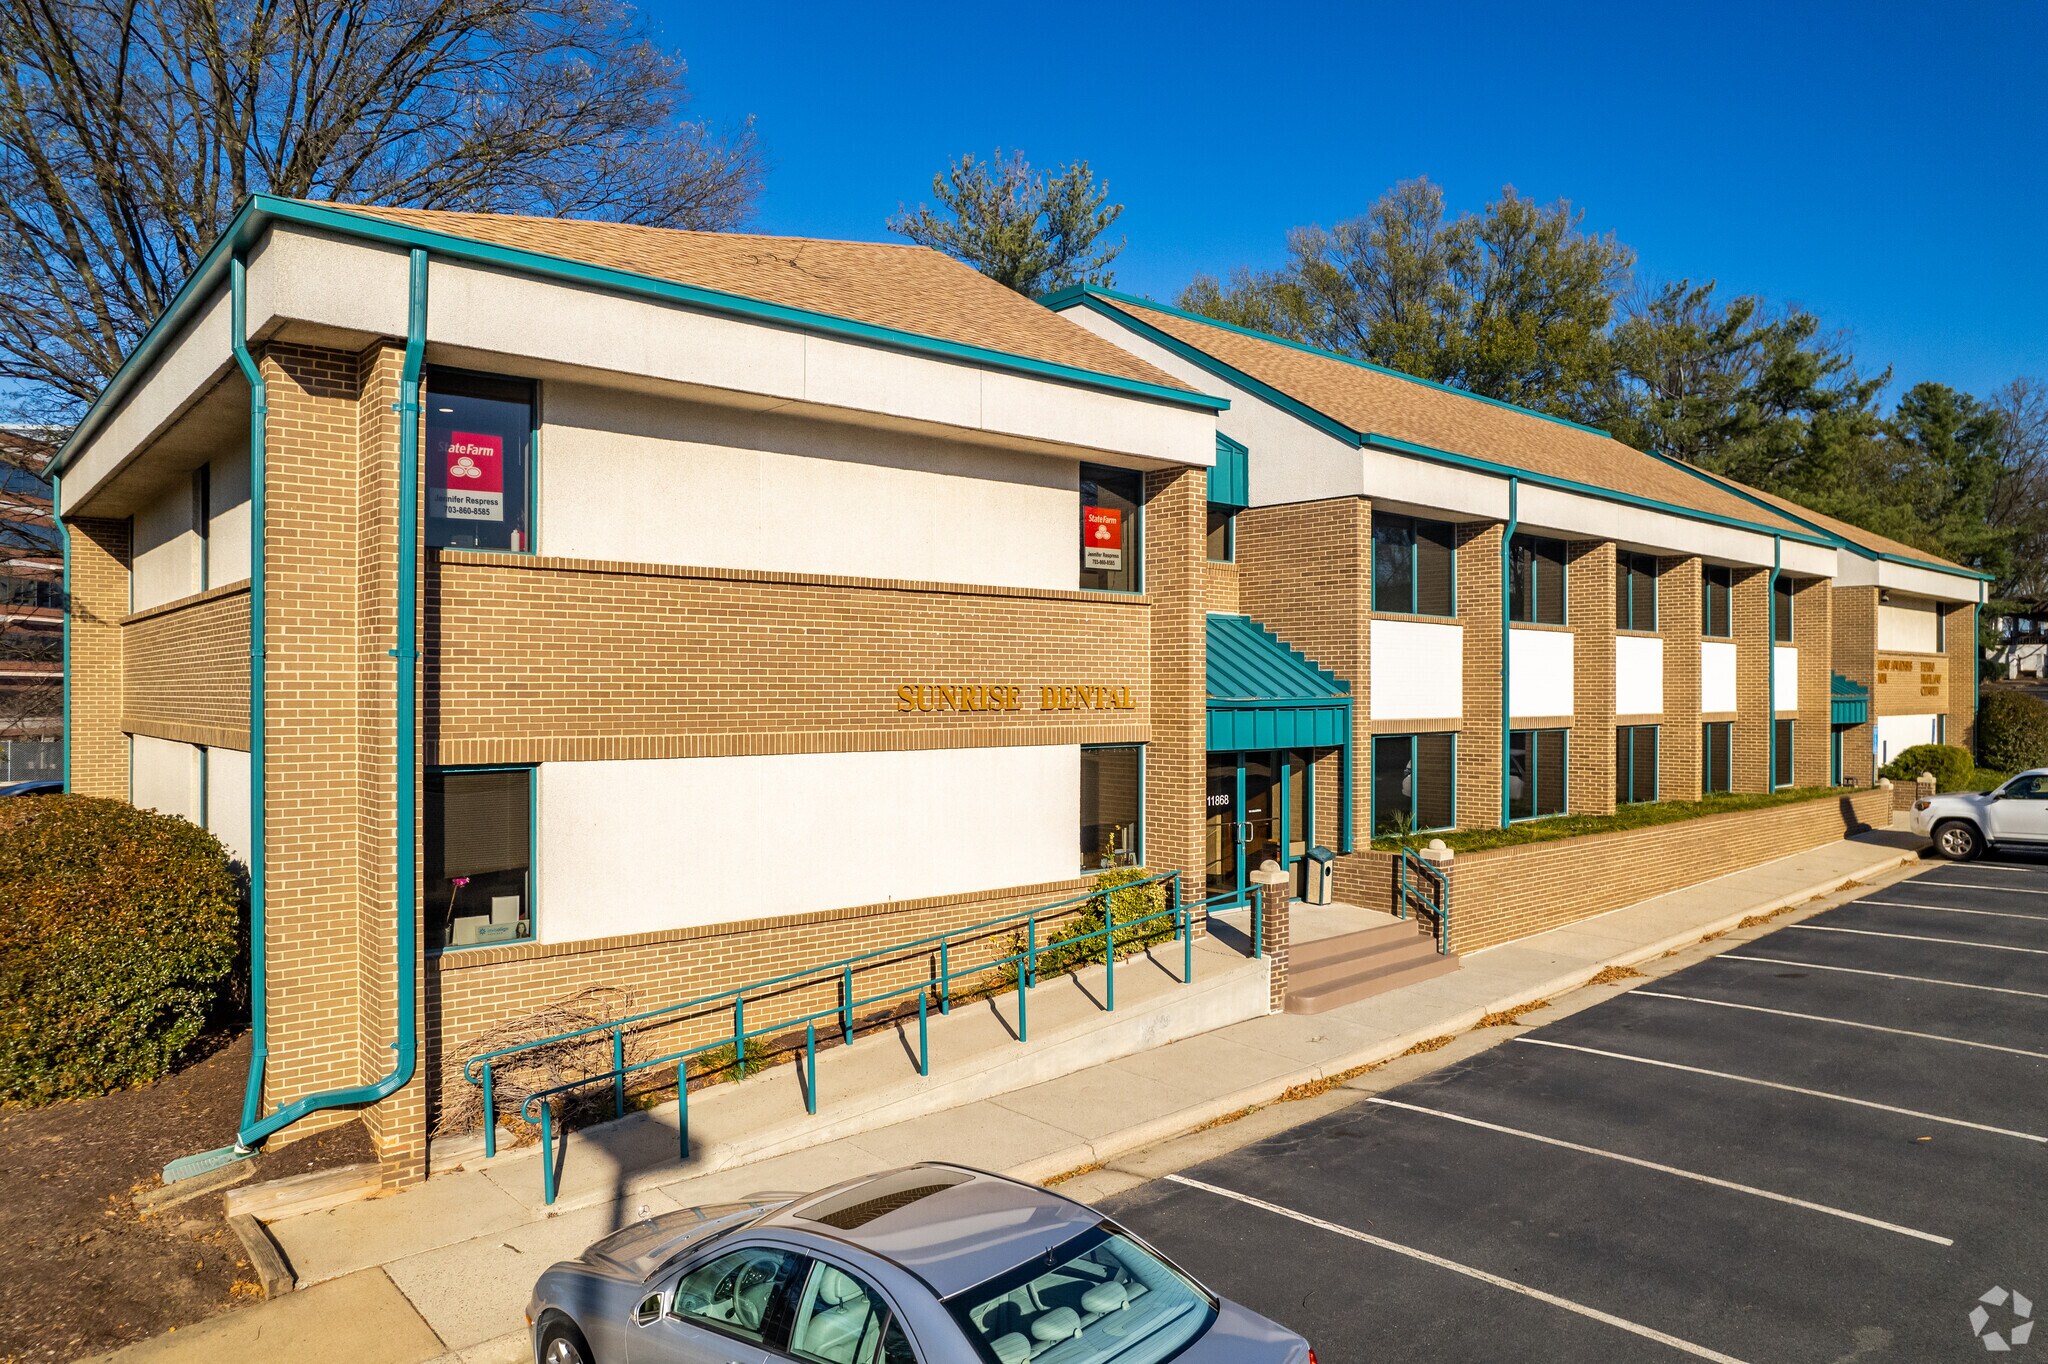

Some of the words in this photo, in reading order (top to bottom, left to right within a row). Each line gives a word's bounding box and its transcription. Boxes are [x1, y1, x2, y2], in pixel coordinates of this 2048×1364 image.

[435, 494, 464, 504] Jennifer
[465, 496, 499, 506] Respress
[444, 505, 490, 516] 703-860-8585
[897, 684, 1022, 712] SUNRISE
[1039, 685, 1137, 710] DENTAL
[1207, 794, 1229, 806] 11868
